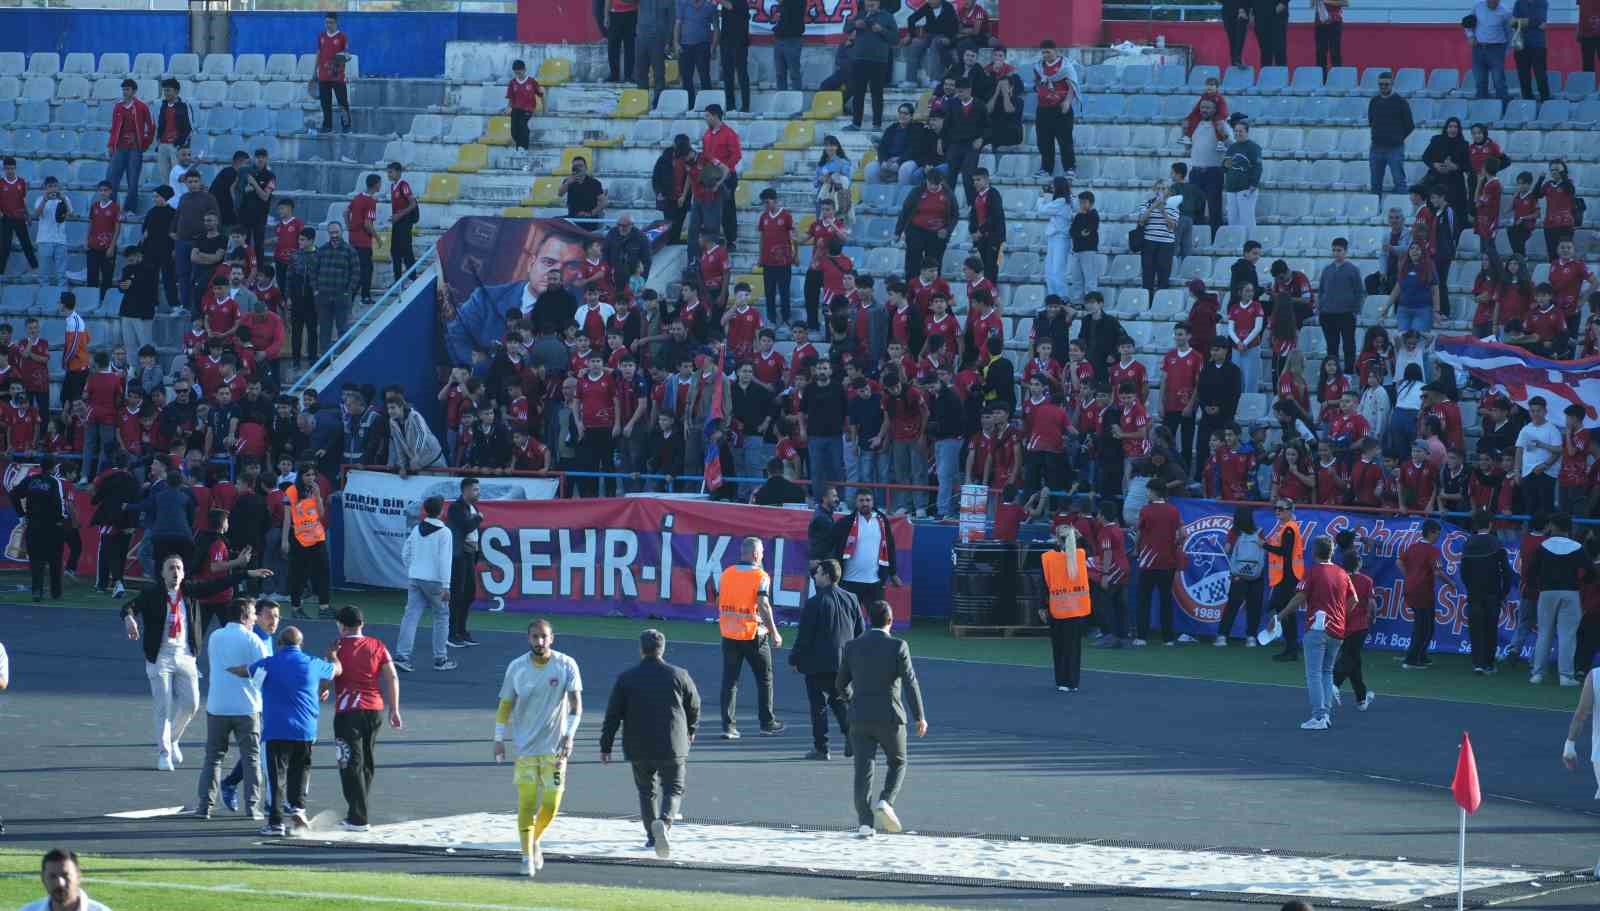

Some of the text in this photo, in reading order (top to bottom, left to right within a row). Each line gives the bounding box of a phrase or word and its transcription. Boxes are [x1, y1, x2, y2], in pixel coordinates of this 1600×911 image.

[480, 514, 672, 612] ŞEHR-İ
[1193, 607, 1222, 620] 1989
[553, 771, 561, 786] 5
